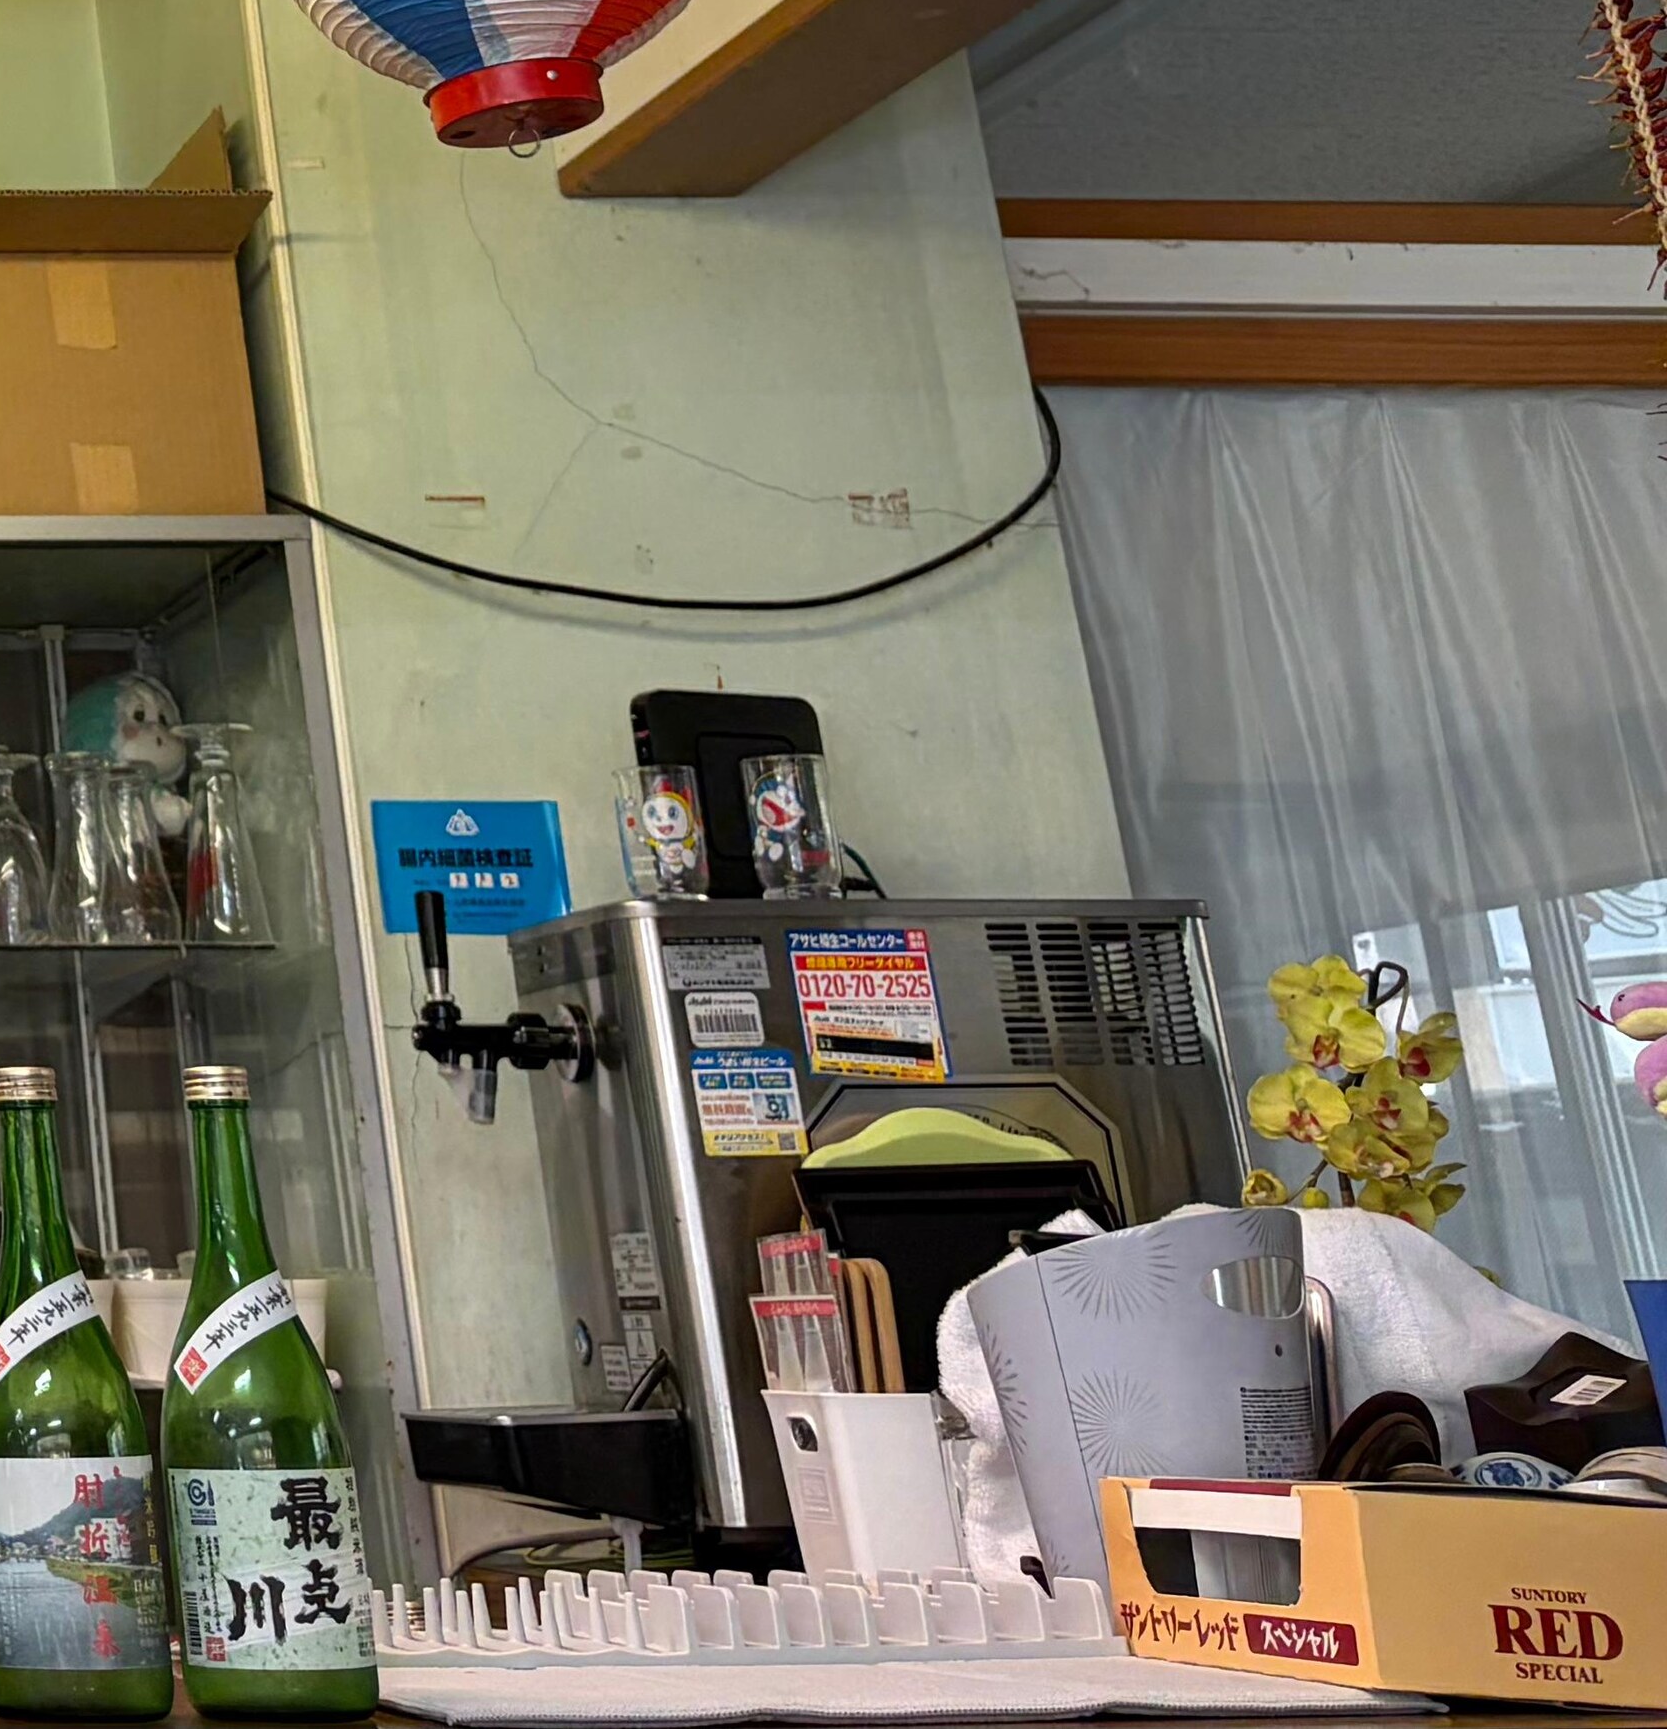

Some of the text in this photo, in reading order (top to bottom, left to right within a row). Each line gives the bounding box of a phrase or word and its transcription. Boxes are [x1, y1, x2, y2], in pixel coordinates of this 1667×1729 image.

[798, 973, 932, 998] 0120-70-2525
[1510, 1587, 1587, 1604] SUNTORY
[1259, 1620, 1341, 1660] スペシャル
[1488, 1603, 1624, 1661] RED
[1515, 1662, 1604, 1684] SPECIAL
